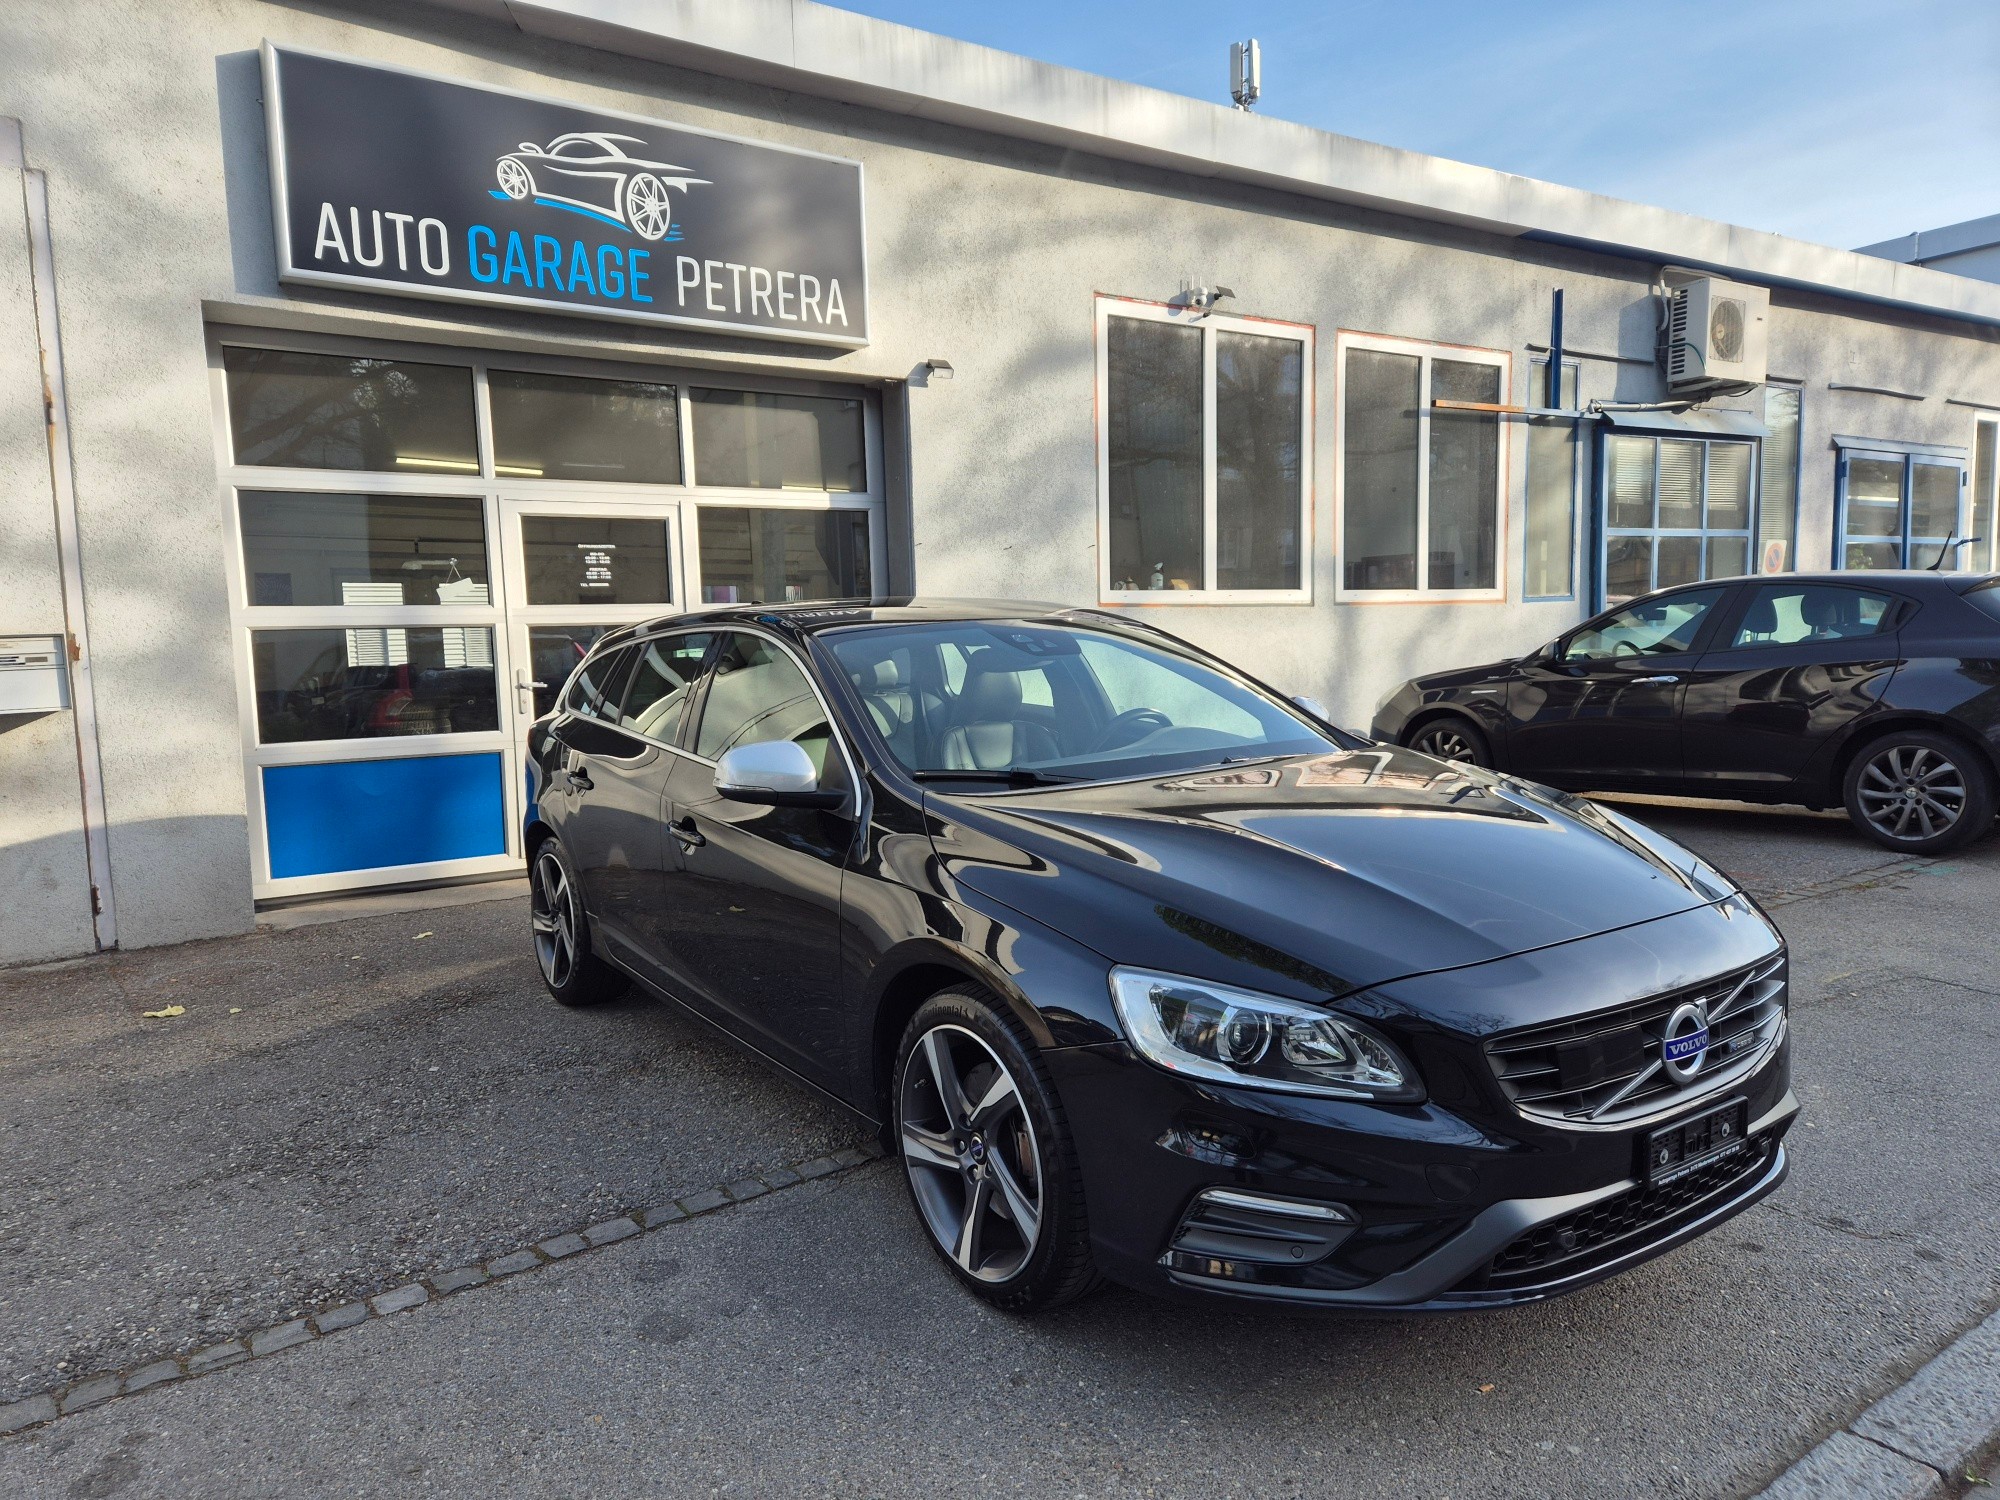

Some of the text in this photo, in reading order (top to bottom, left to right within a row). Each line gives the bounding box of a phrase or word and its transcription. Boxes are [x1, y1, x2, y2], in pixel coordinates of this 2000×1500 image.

[313, 201, 849, 328] AUTO GARAGE PETRERA
[1669, 1034, 1708, 1055] VOLVO
